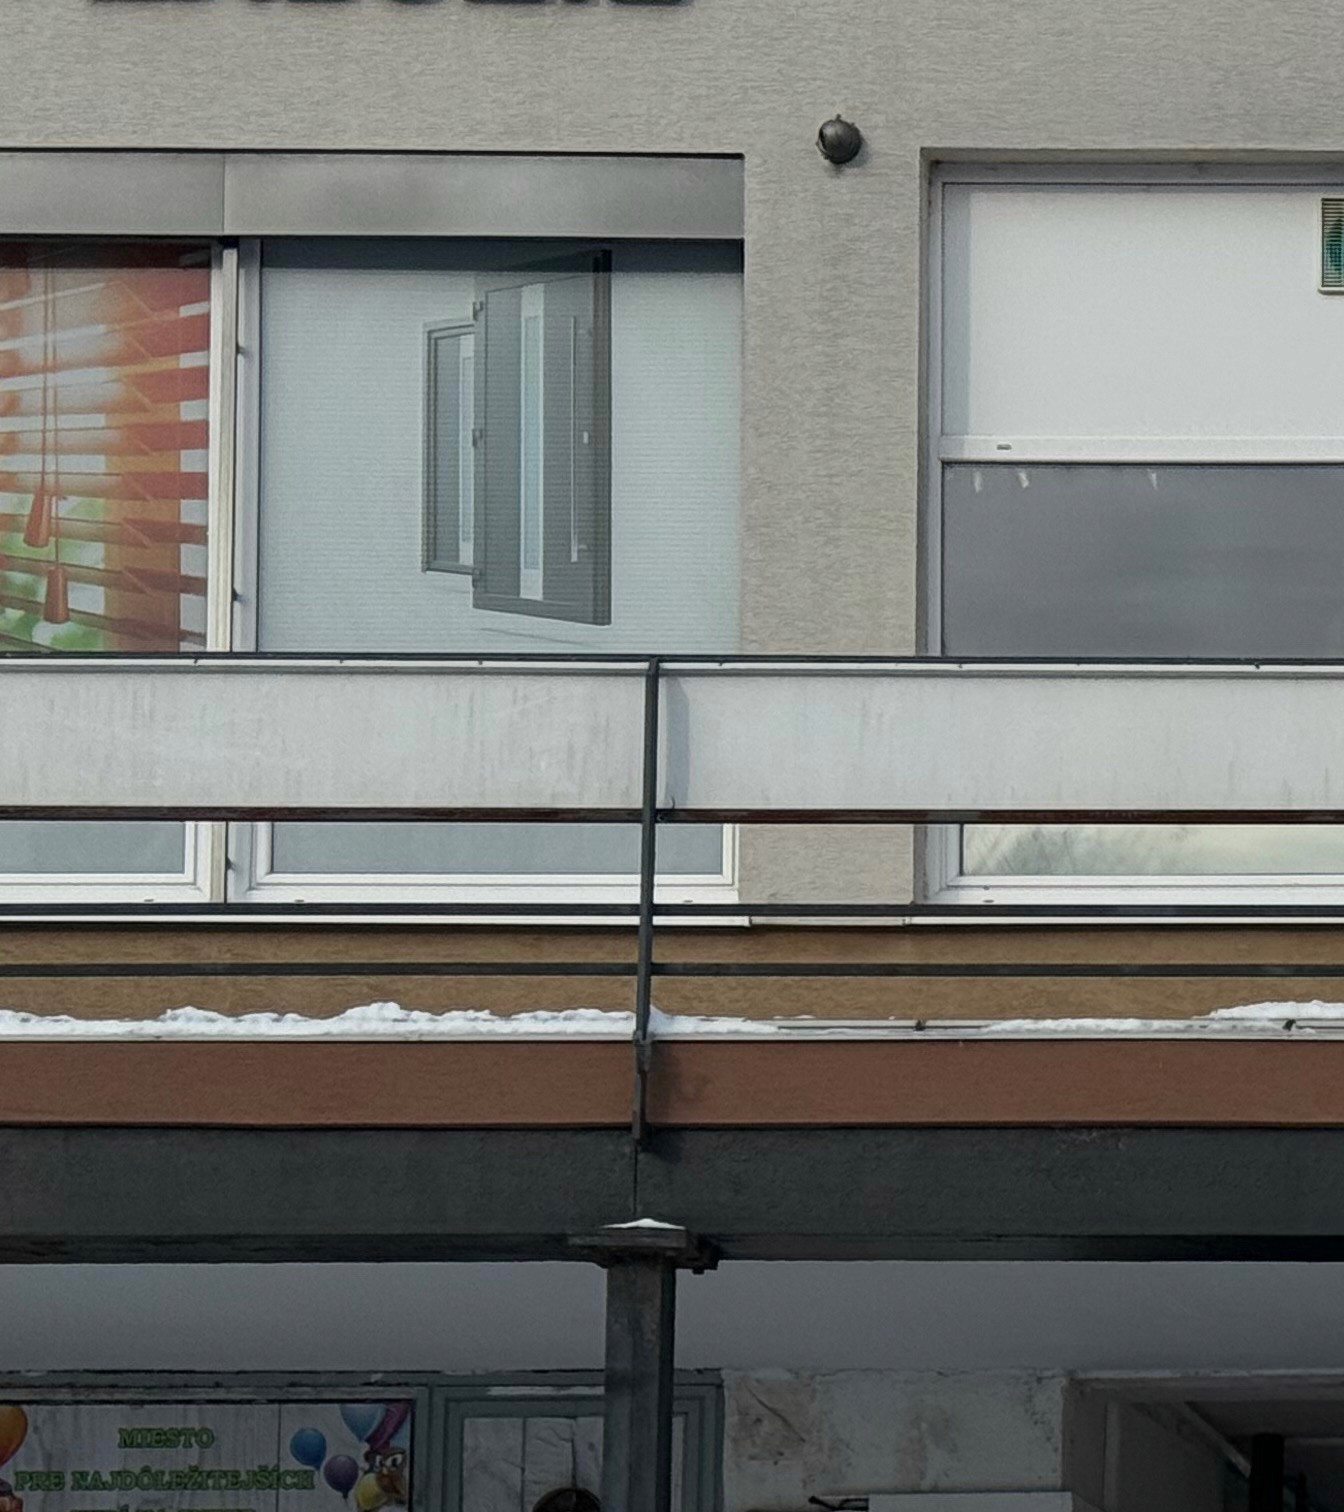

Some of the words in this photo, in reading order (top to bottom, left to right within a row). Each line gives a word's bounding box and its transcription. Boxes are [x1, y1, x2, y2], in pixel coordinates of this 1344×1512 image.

[118, 1427, 215, 1448] MIESTO
[15, 1470, 65, 1492] PRE
[71, 1465, 315, 1492] NAJDÔLEŽITEJŠÍCH
